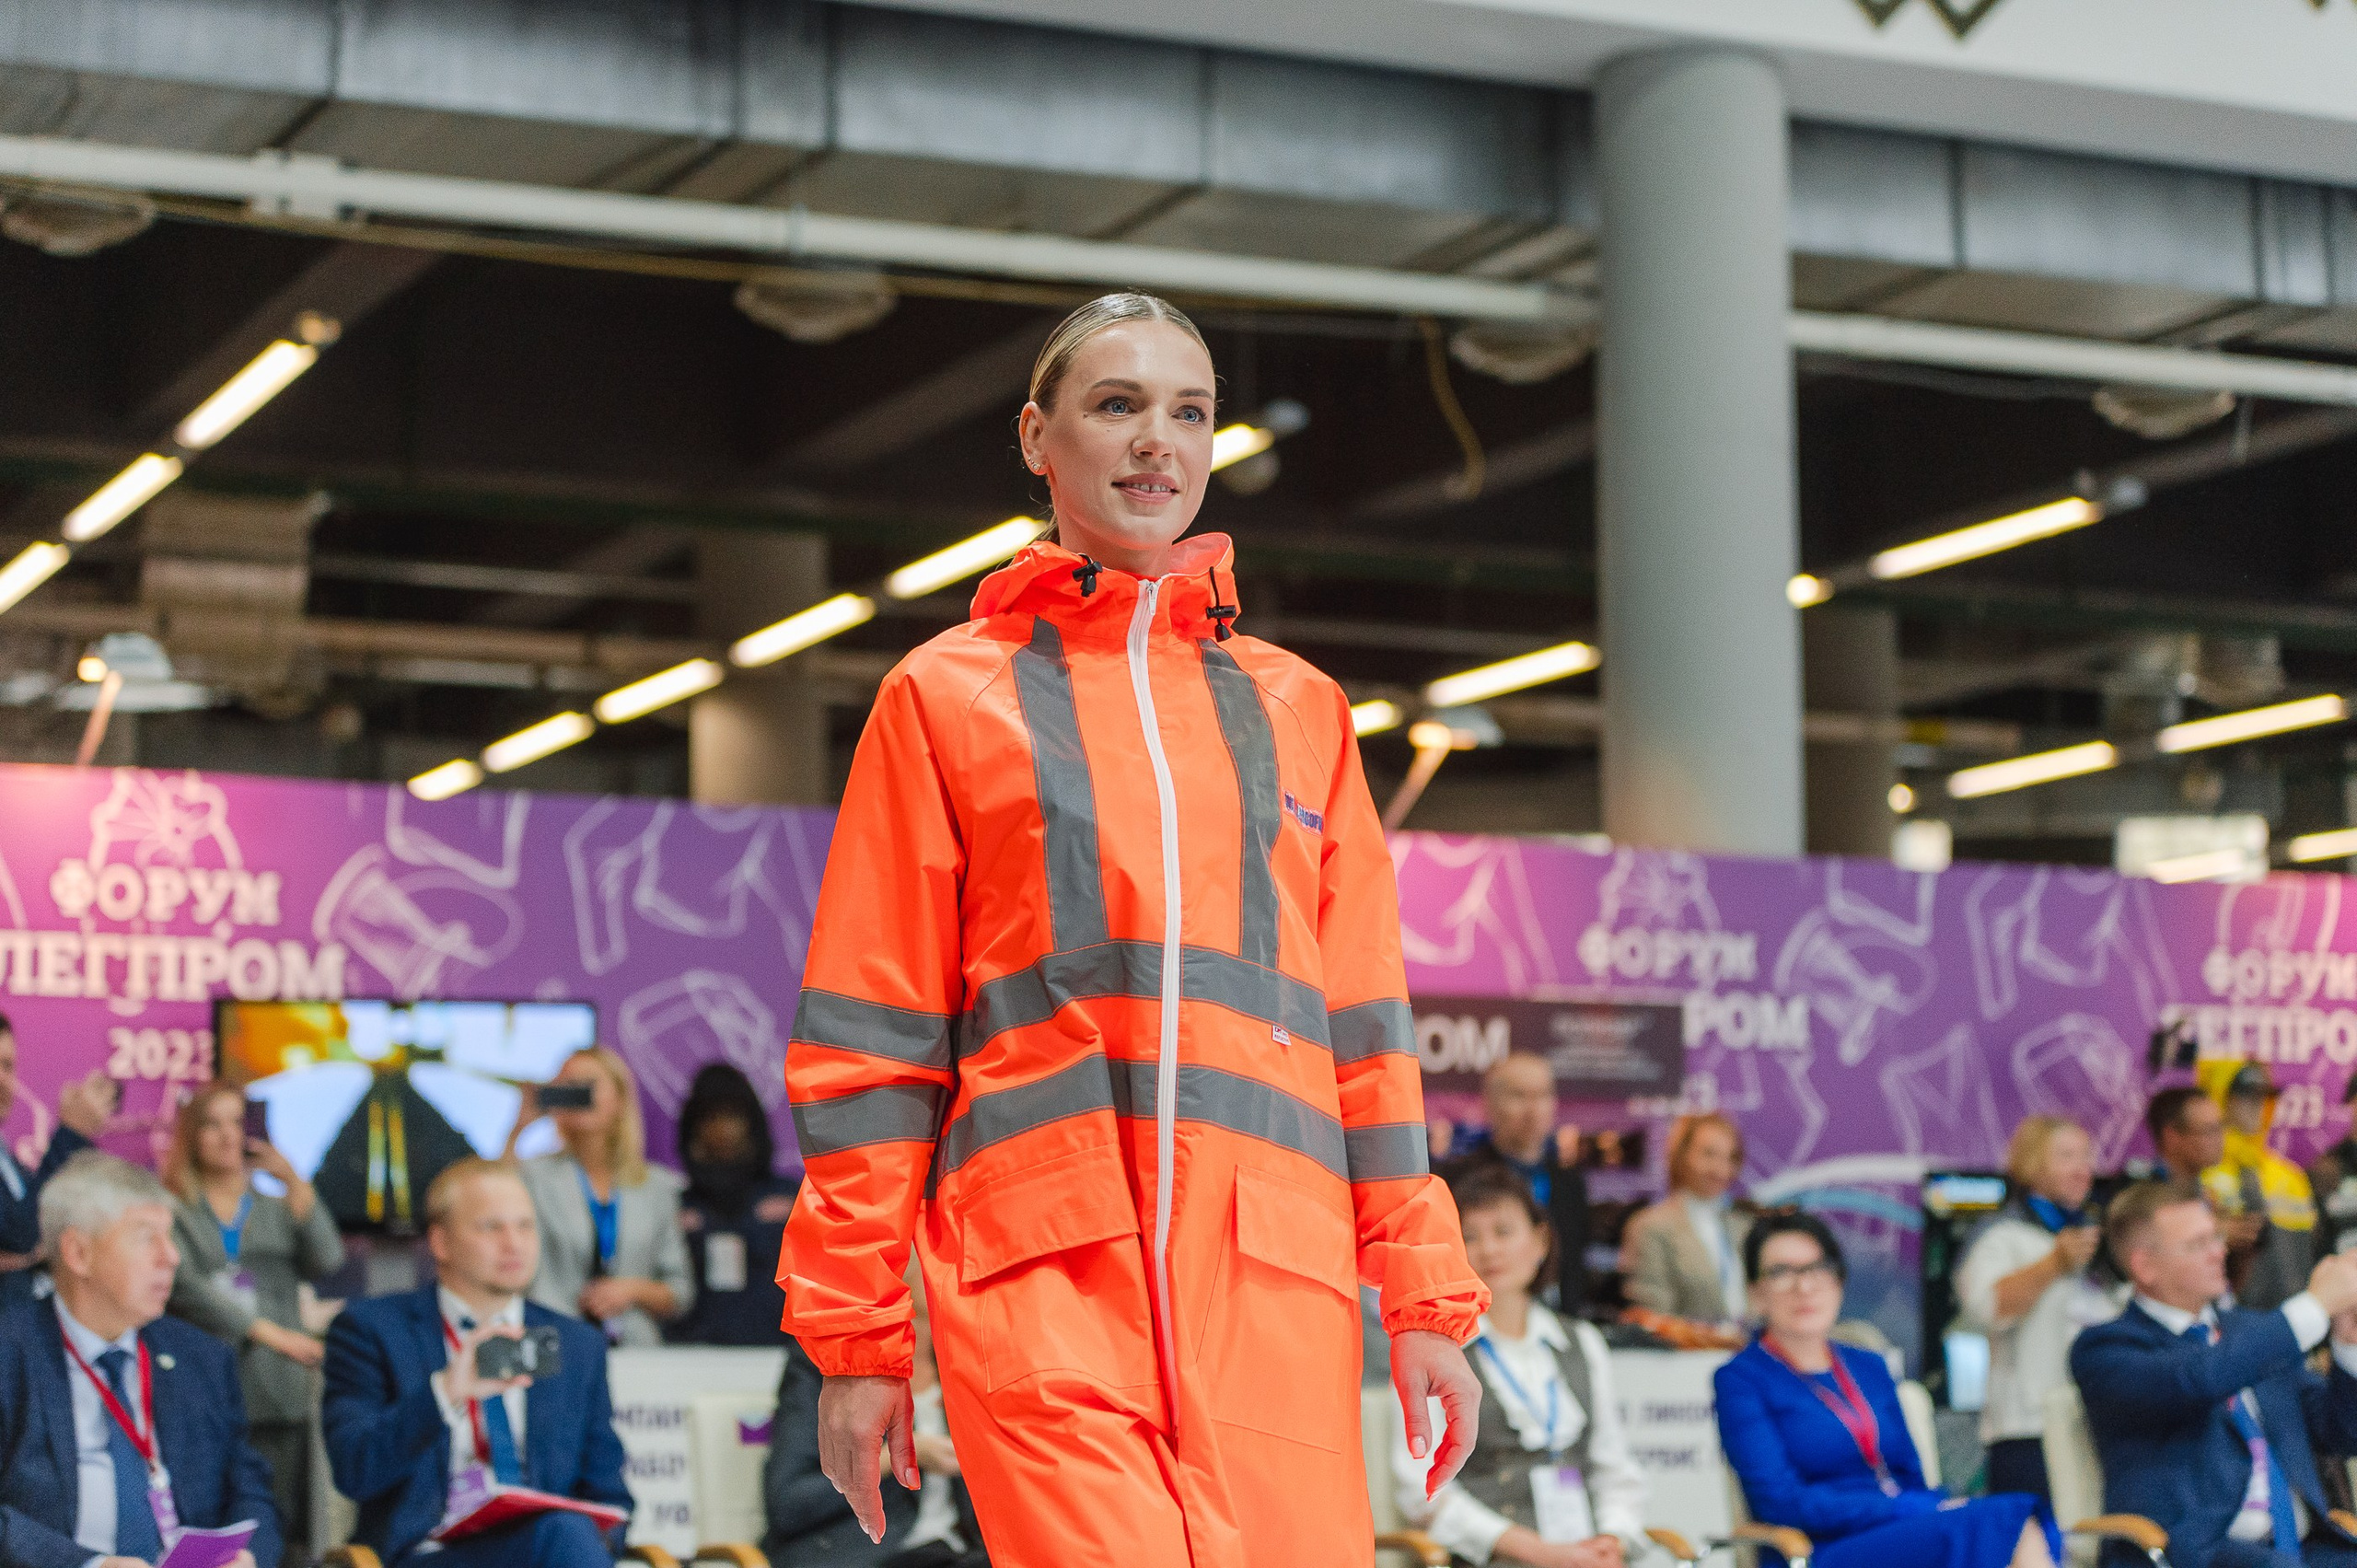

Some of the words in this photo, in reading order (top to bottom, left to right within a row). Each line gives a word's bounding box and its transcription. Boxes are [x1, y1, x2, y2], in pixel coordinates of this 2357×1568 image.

[49, 857, 282, 926] ФОРУМ
[0, 928, 347, 1003] ЛЕГПРОМ
[1576, 923, 1756, 981] ФОРУМ
